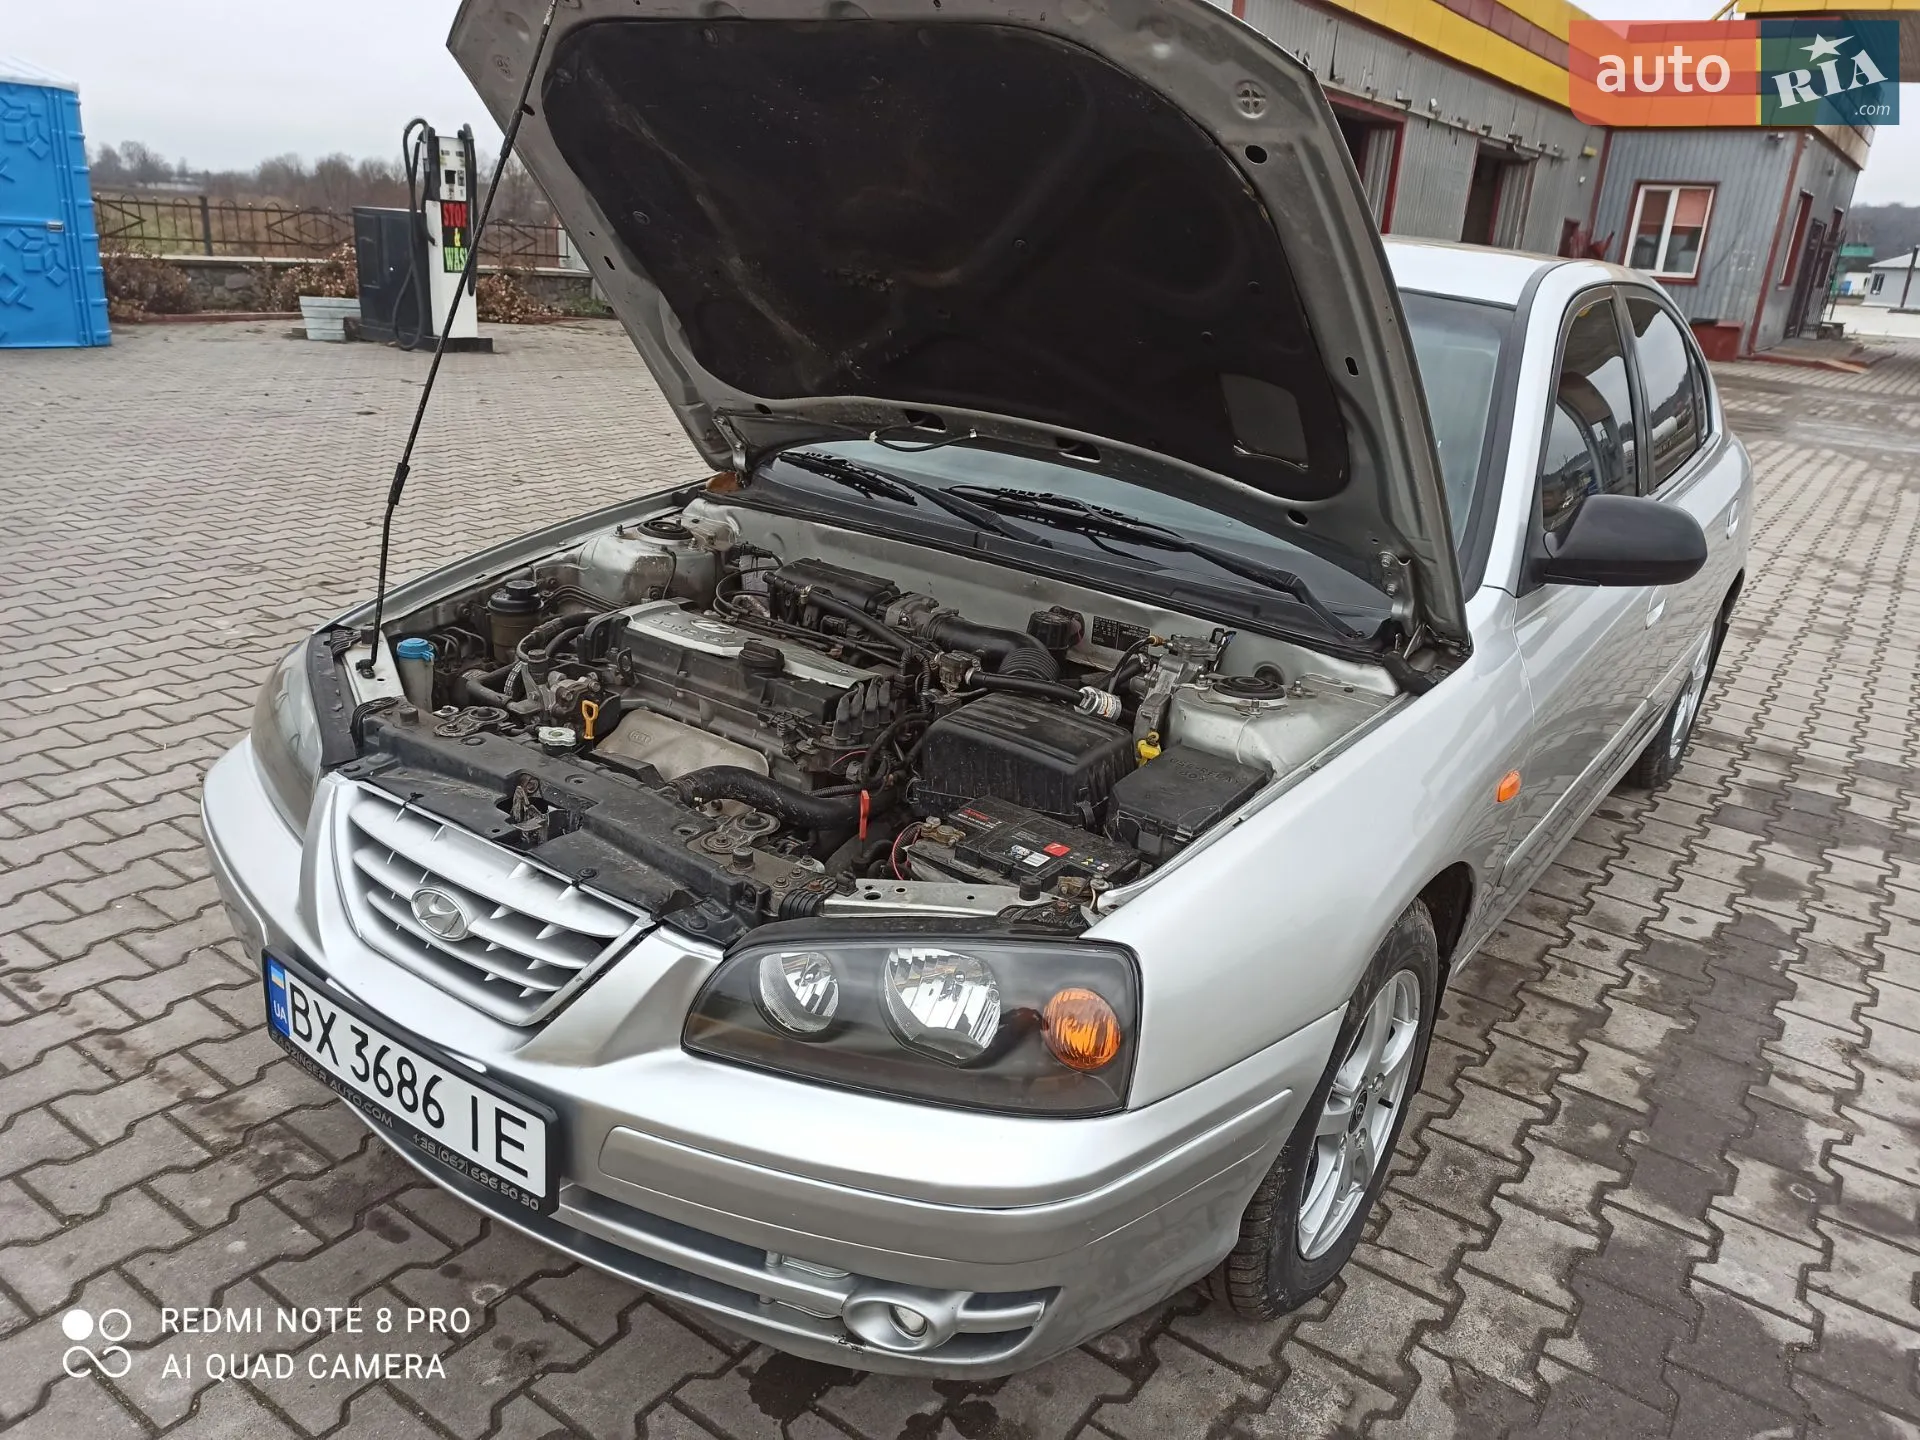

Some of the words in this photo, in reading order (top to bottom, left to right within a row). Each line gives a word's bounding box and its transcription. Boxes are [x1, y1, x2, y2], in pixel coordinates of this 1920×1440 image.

[444, 247, 469, 270] WAS
[273, 1000, 288, 1024] UA
[289, 982, 339, 1067] BX
[350, 1024, 445, 1129] 3686
[471, 1095, 528, 1179] IE
[412, 1133, 436, 1154] +38
[438, 1146, 468, 1174] (067)
[471, 1167, 498, 1190] 696
[500, 1182, 518, 1200] 50
[521, 1194, 539, 1211] 30
